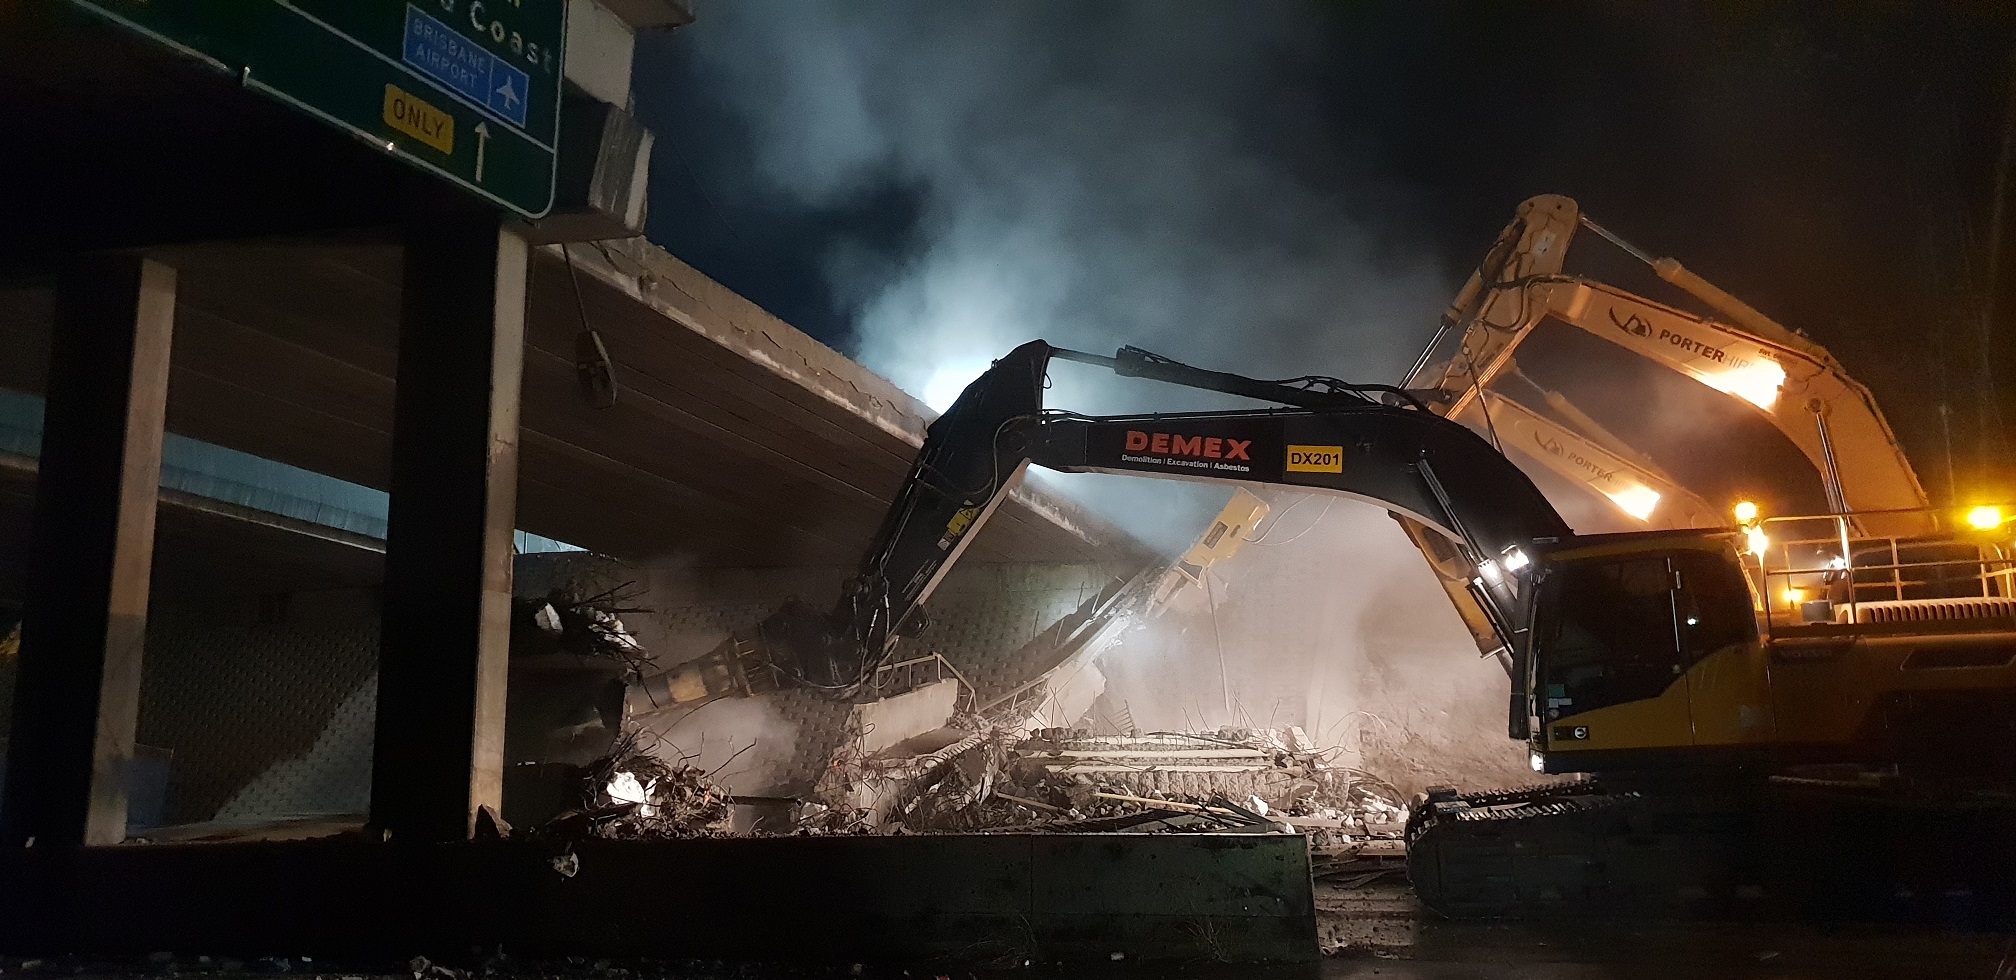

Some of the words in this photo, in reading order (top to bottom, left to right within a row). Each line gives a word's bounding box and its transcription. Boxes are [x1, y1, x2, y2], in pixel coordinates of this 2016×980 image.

[413, 18, 485, 74] BRISBANE
[470, 1, 552, 74] Coast
[416, 43, 478, 87] AIRPORT
[393, 98, 444, 139] ONLY
[1121, 453, 1162, 465] Demolition
[1166, 458, 1209, 469] Excavation
[1213, 462, 1250, 473] Asbestos
[1125, 430, 1251, 461] DEMEX
[1291, 452, 1340, 466] DX201
